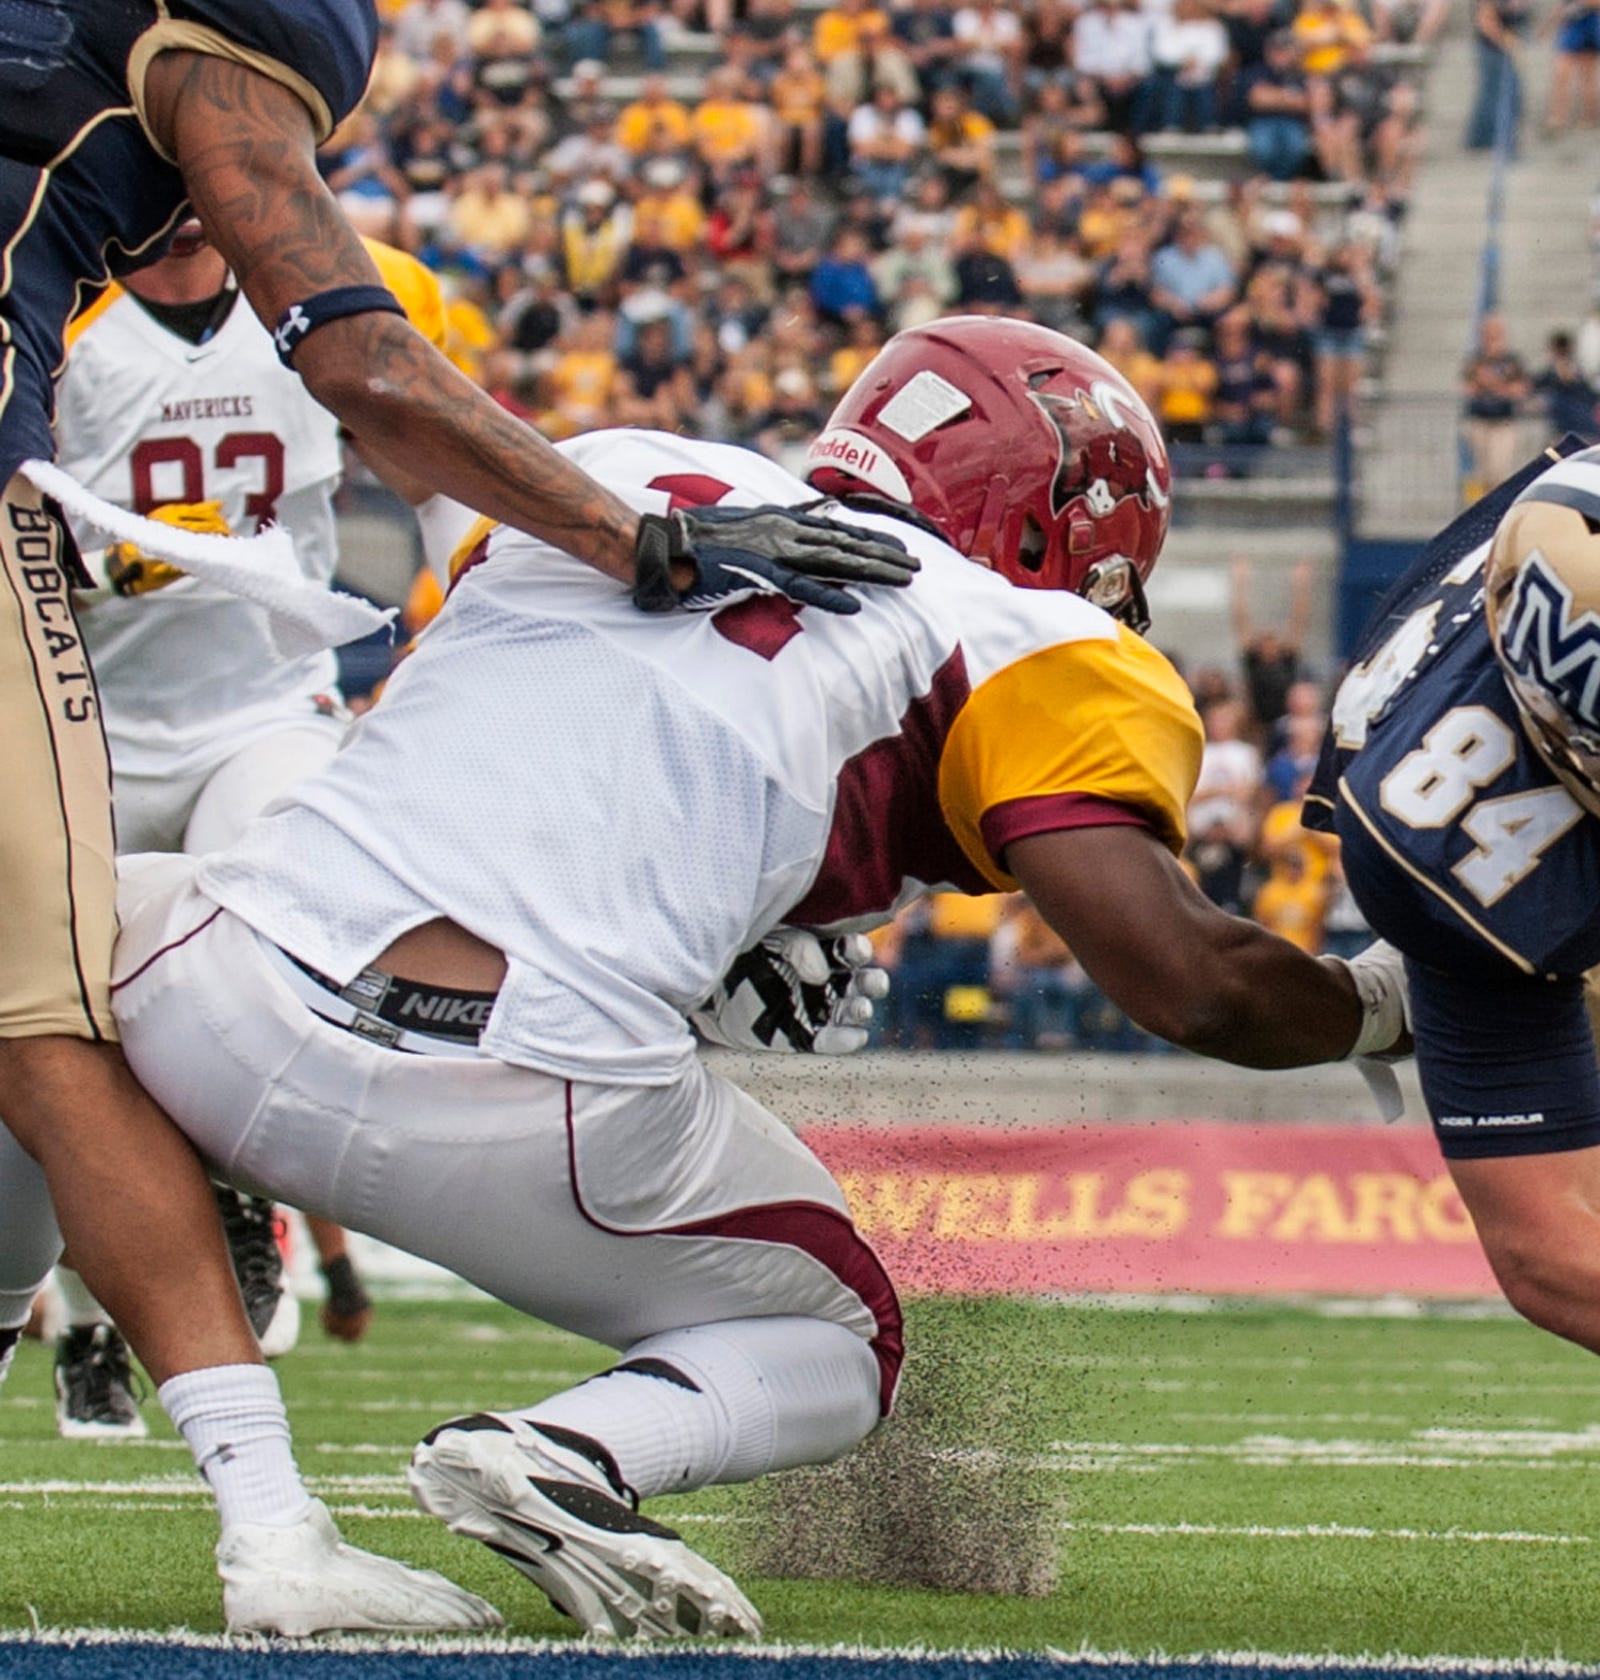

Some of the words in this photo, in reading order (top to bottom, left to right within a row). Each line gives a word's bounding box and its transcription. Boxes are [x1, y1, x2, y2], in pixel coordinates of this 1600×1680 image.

[160, 396, 253, 422] MAVERICKS
[8, 502, 98, 723] BOBCATS
[1379, 704, 1587, 909] 84
[399, 992, 495, 1026] NIKE
[842, 1168, 1190, 1241] WELLS
